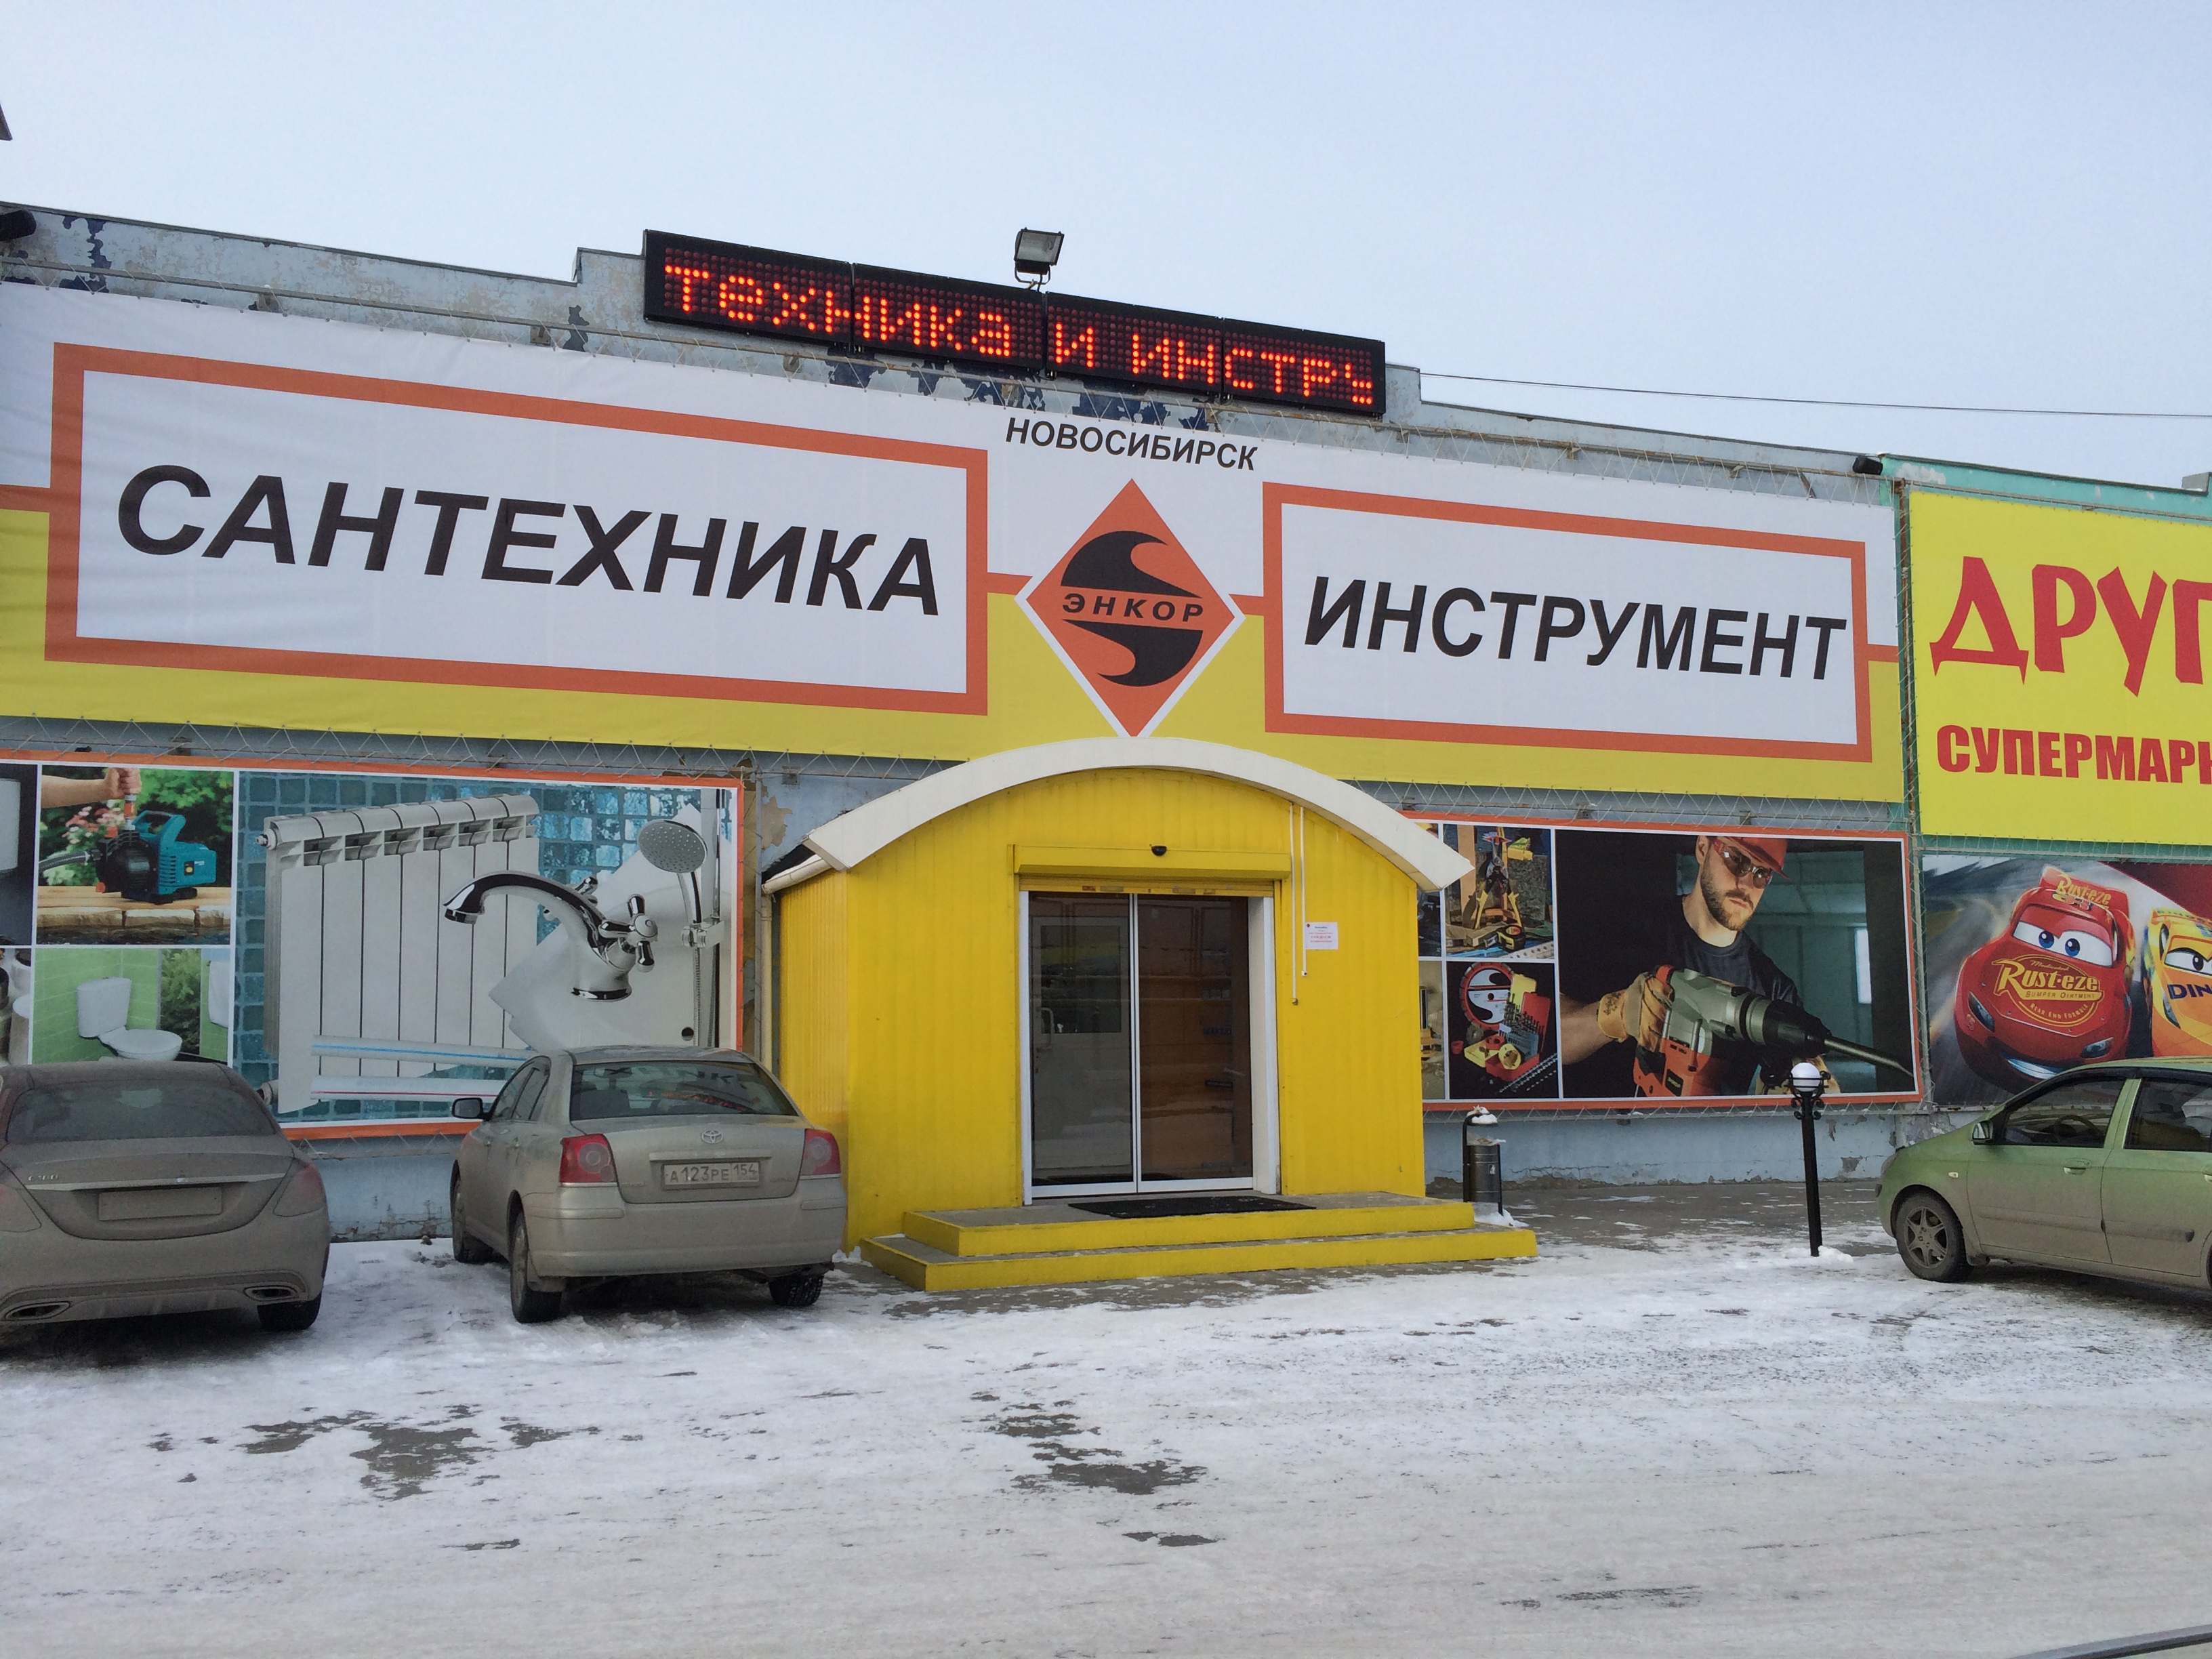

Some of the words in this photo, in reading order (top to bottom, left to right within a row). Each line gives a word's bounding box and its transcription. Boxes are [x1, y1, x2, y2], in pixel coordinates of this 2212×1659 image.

[1005, 417, 1258, 471] НОВОСИБИРСК
[118, 464, 939, 616] САНТЕХНИКА
[1061, 592, 1204, 623] ЭНКОР
[1305, 575, 1848, 680] ИНСТРУМЕНТ
